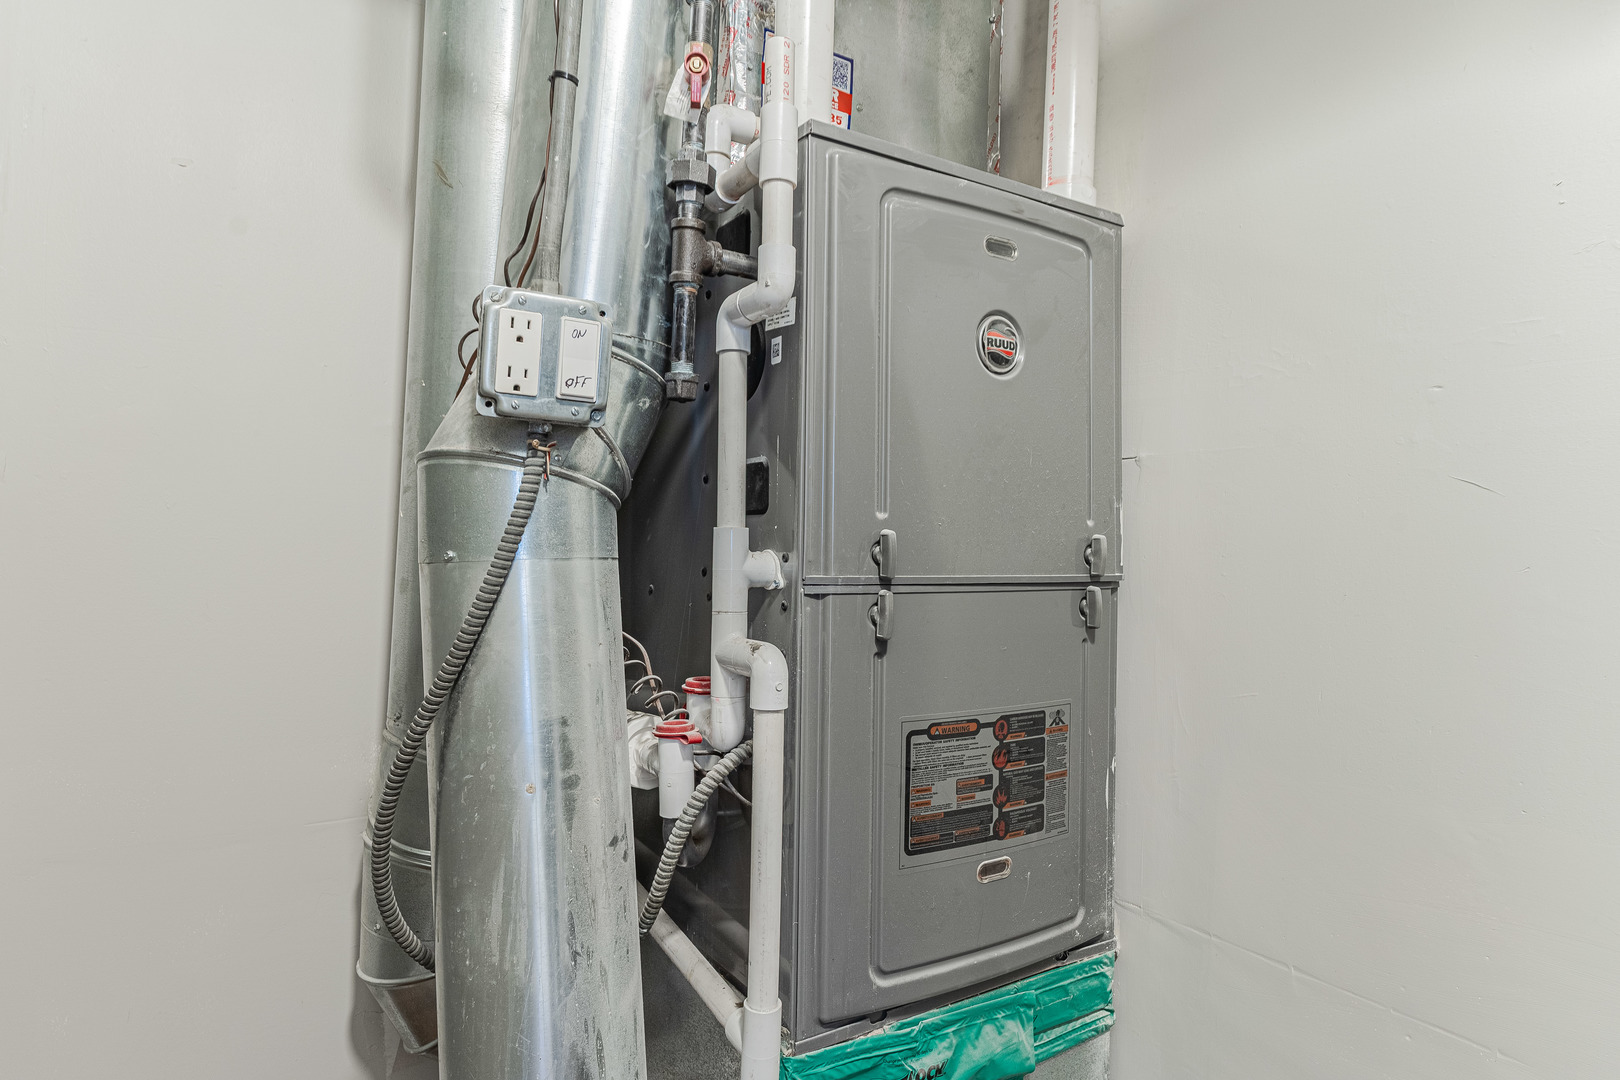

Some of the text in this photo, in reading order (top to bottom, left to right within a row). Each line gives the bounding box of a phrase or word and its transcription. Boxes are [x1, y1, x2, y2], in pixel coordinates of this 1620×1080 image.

[571, 328, 588, 339] ON
[987, 337, 1015, 351] RUUD
[565, 375, 593, 389] OFF
[941, 725, 971, 734] WARNING
